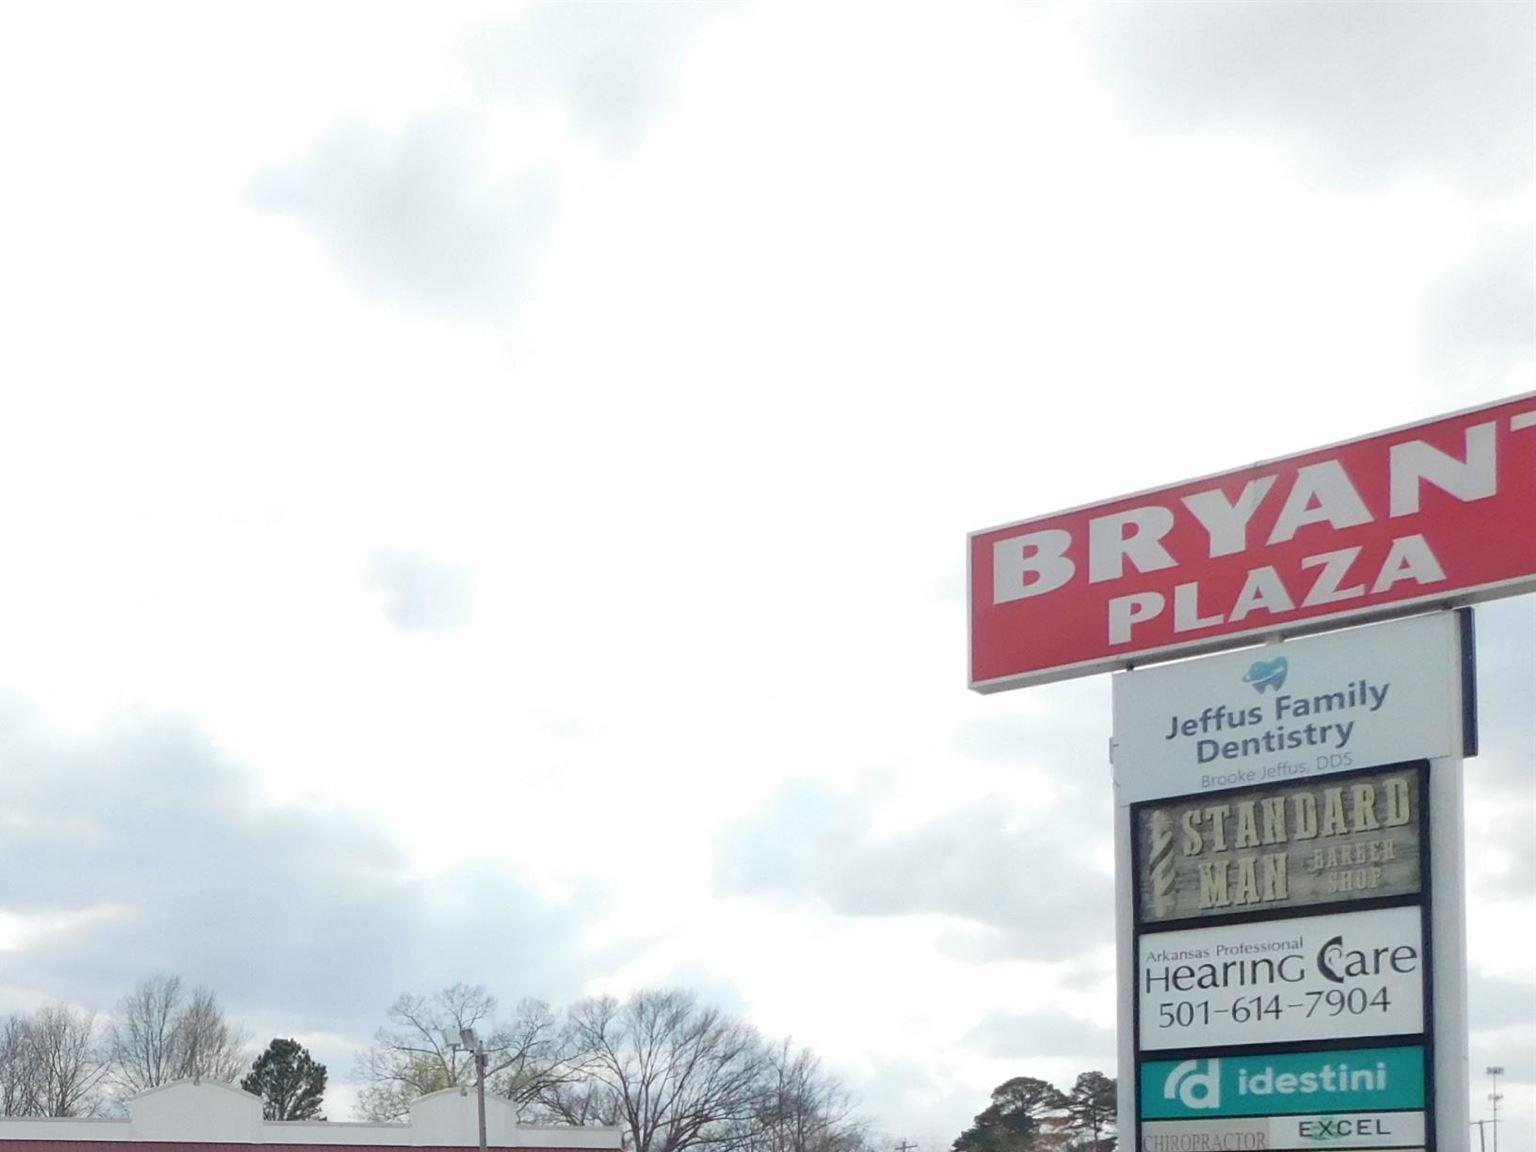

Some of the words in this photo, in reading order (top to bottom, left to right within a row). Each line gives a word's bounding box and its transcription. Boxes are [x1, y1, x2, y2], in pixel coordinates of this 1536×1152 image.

[993, 409, 1536, 605] BRYAN
[1109, 533, 1447, 646] PLAZA
[1165, 705, 1263, 740] Jeffus
[1275, 679, 1391, 720] Family
[1196, 720, 1355, 764] Dentistry
[1200, 768, 1256, 789] Brooke
[1316, 751, 1354, 771] DDS
[1183, 777, 1411, 857] STANDARD
[1199, 851, 1290, 910] MAN
[1327, 867, 1383, 894] SHOP
[1146, 948, 1211, 963] Arkansas
[1215, 936, 1304, 958] Professional
[1316, 935, 1418, 984] Care
[1158, 985, 1392, 1029] 501-614-7904
[1237, 1061, 1387, 1096] idestini
[1143, 1131, 1266, 1152] CHIROPRACTOR
[1298, 1118, 1392, 1138] EXCEL
